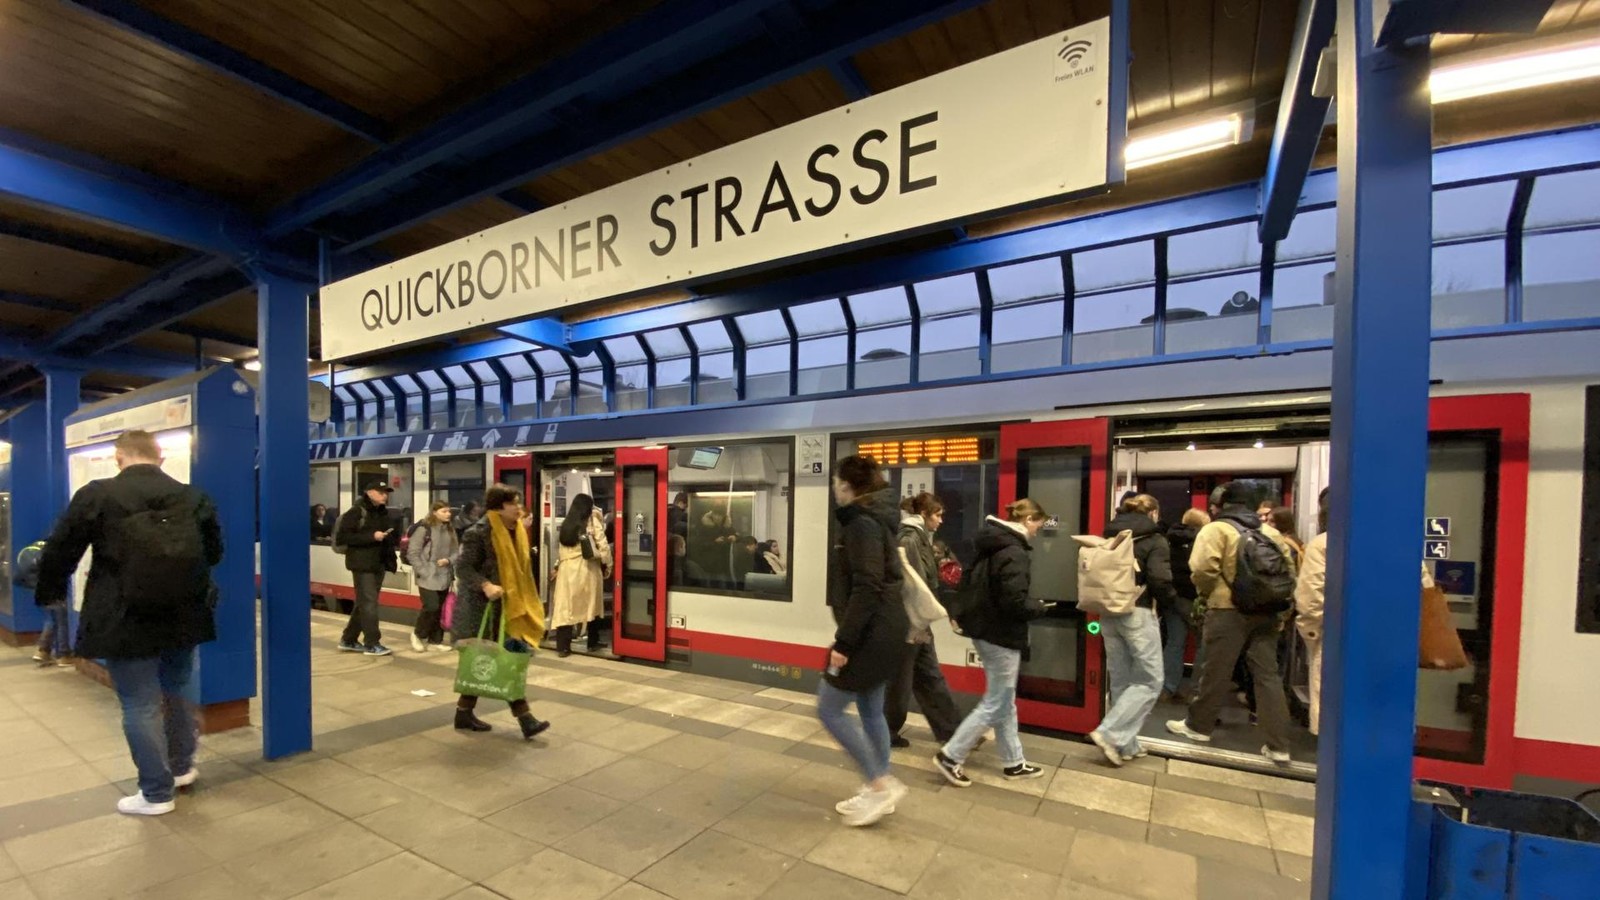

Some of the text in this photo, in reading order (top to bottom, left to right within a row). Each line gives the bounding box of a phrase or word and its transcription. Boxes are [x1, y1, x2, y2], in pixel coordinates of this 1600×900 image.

[1055, 66, 1094, 82] Freies WLAN
[361, 111, 939, 331] QUICKBORNER STRASSE
